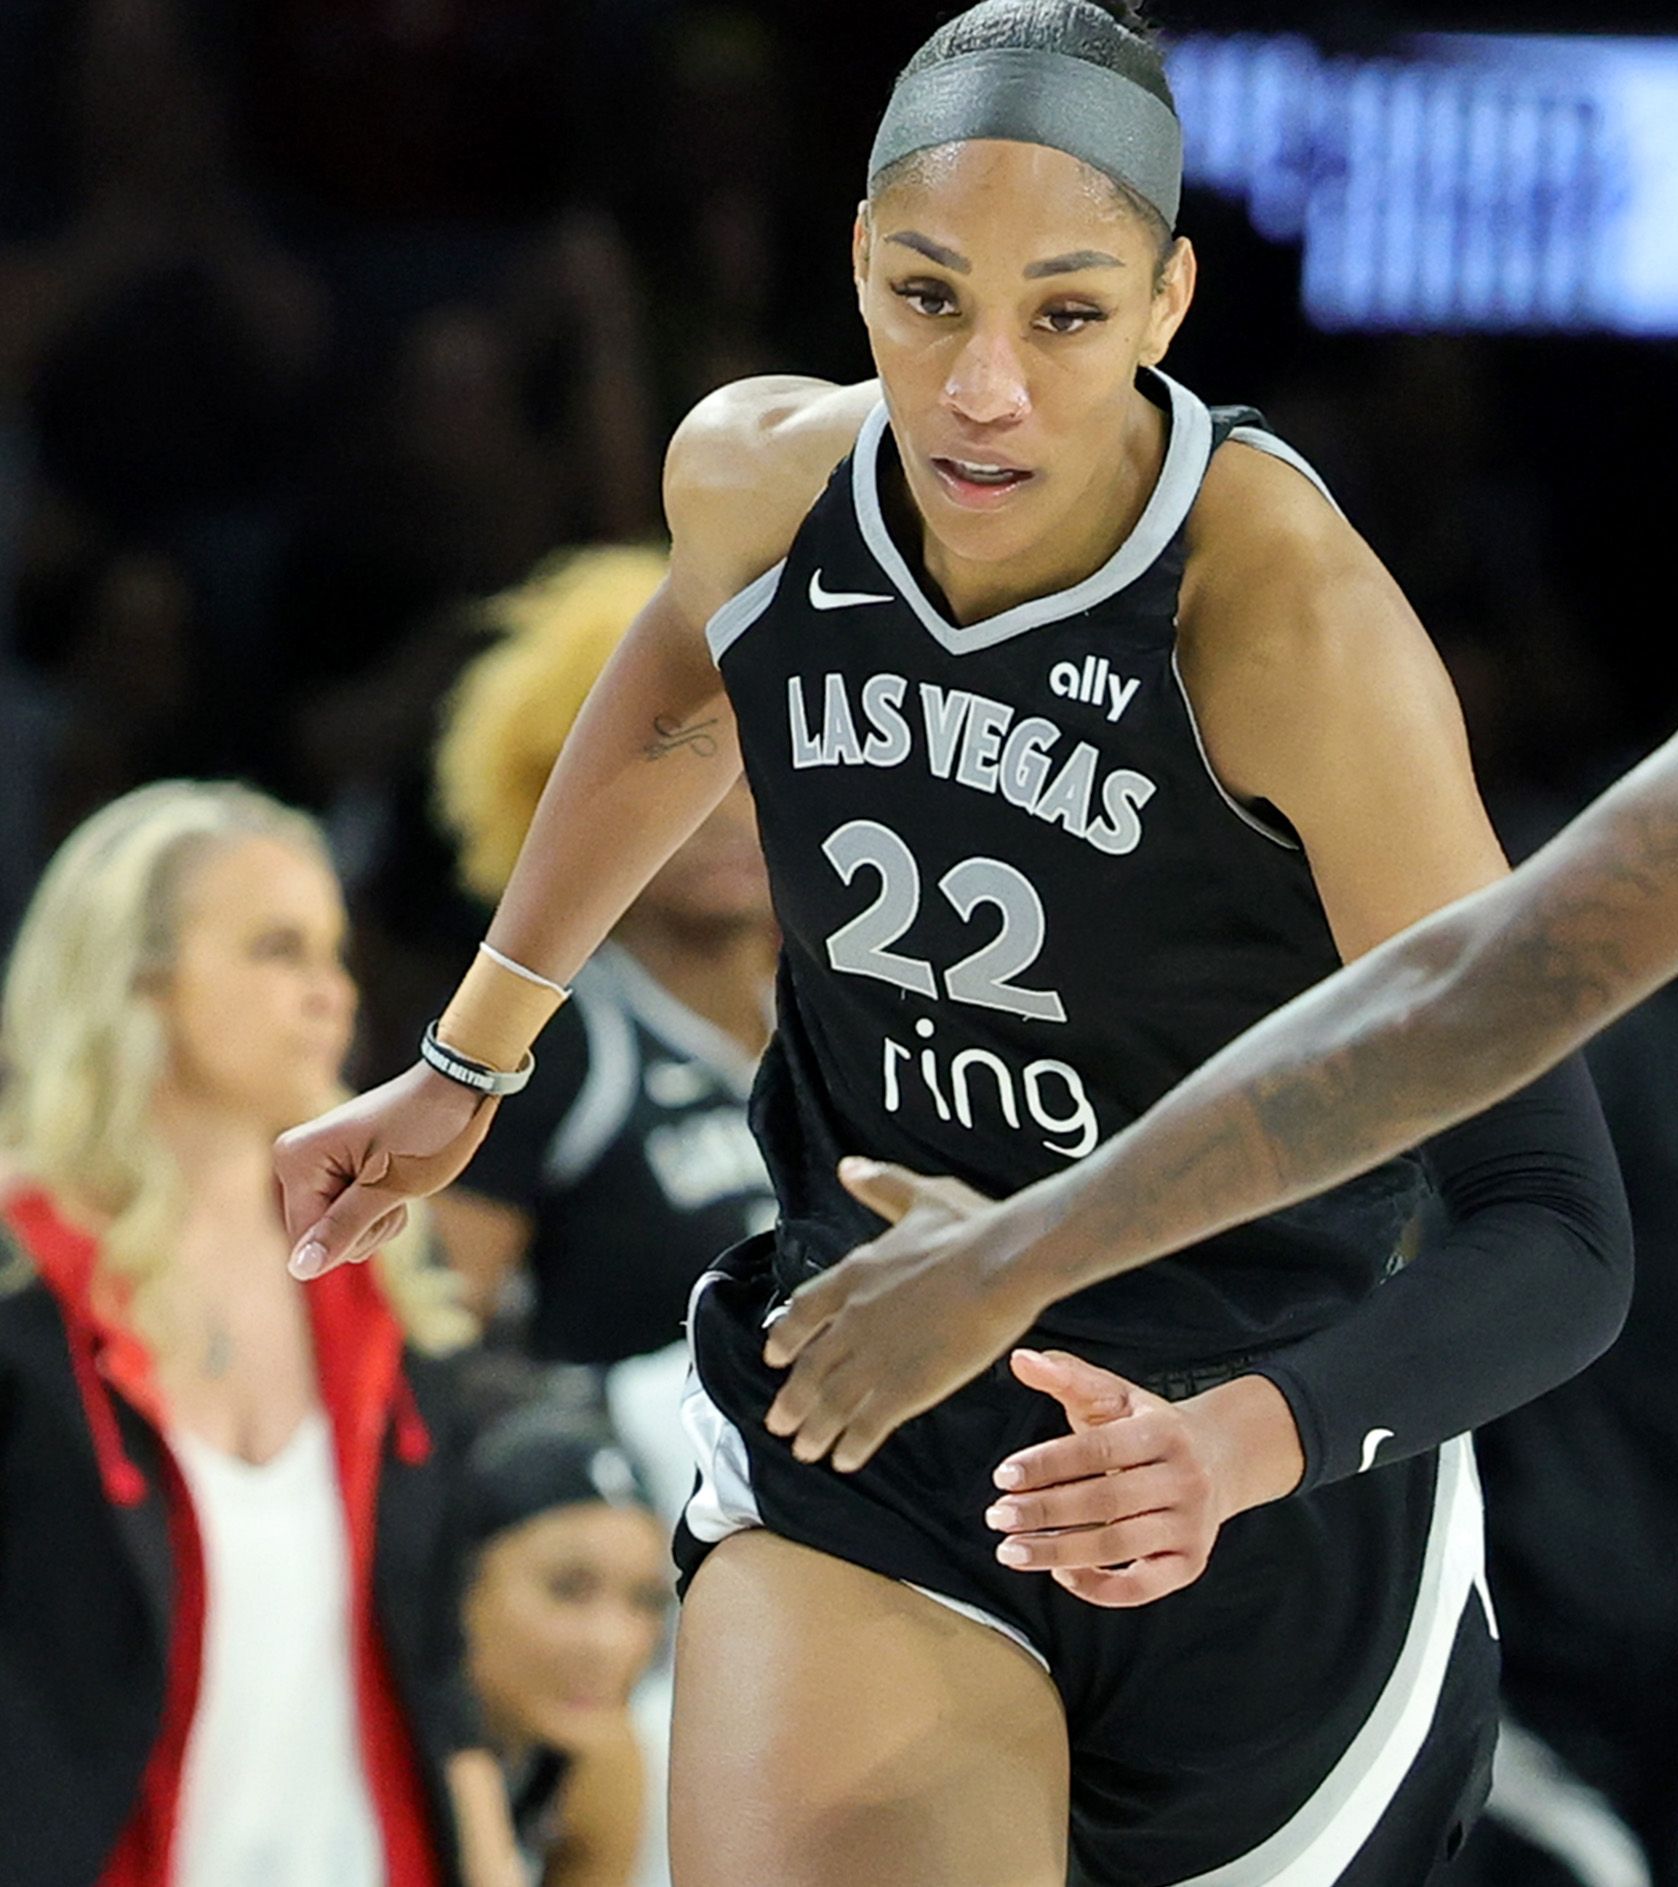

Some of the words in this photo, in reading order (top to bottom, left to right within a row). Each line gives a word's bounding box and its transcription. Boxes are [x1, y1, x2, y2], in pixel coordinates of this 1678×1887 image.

[787, 673, 912, 770] LAS
[919, 682, 1158, 855] VEGAS
[1048, 655, 1141, 722] ally
[821, 819, 1068, 1023] 22
[882, 1018, 1098, 1159] ring
